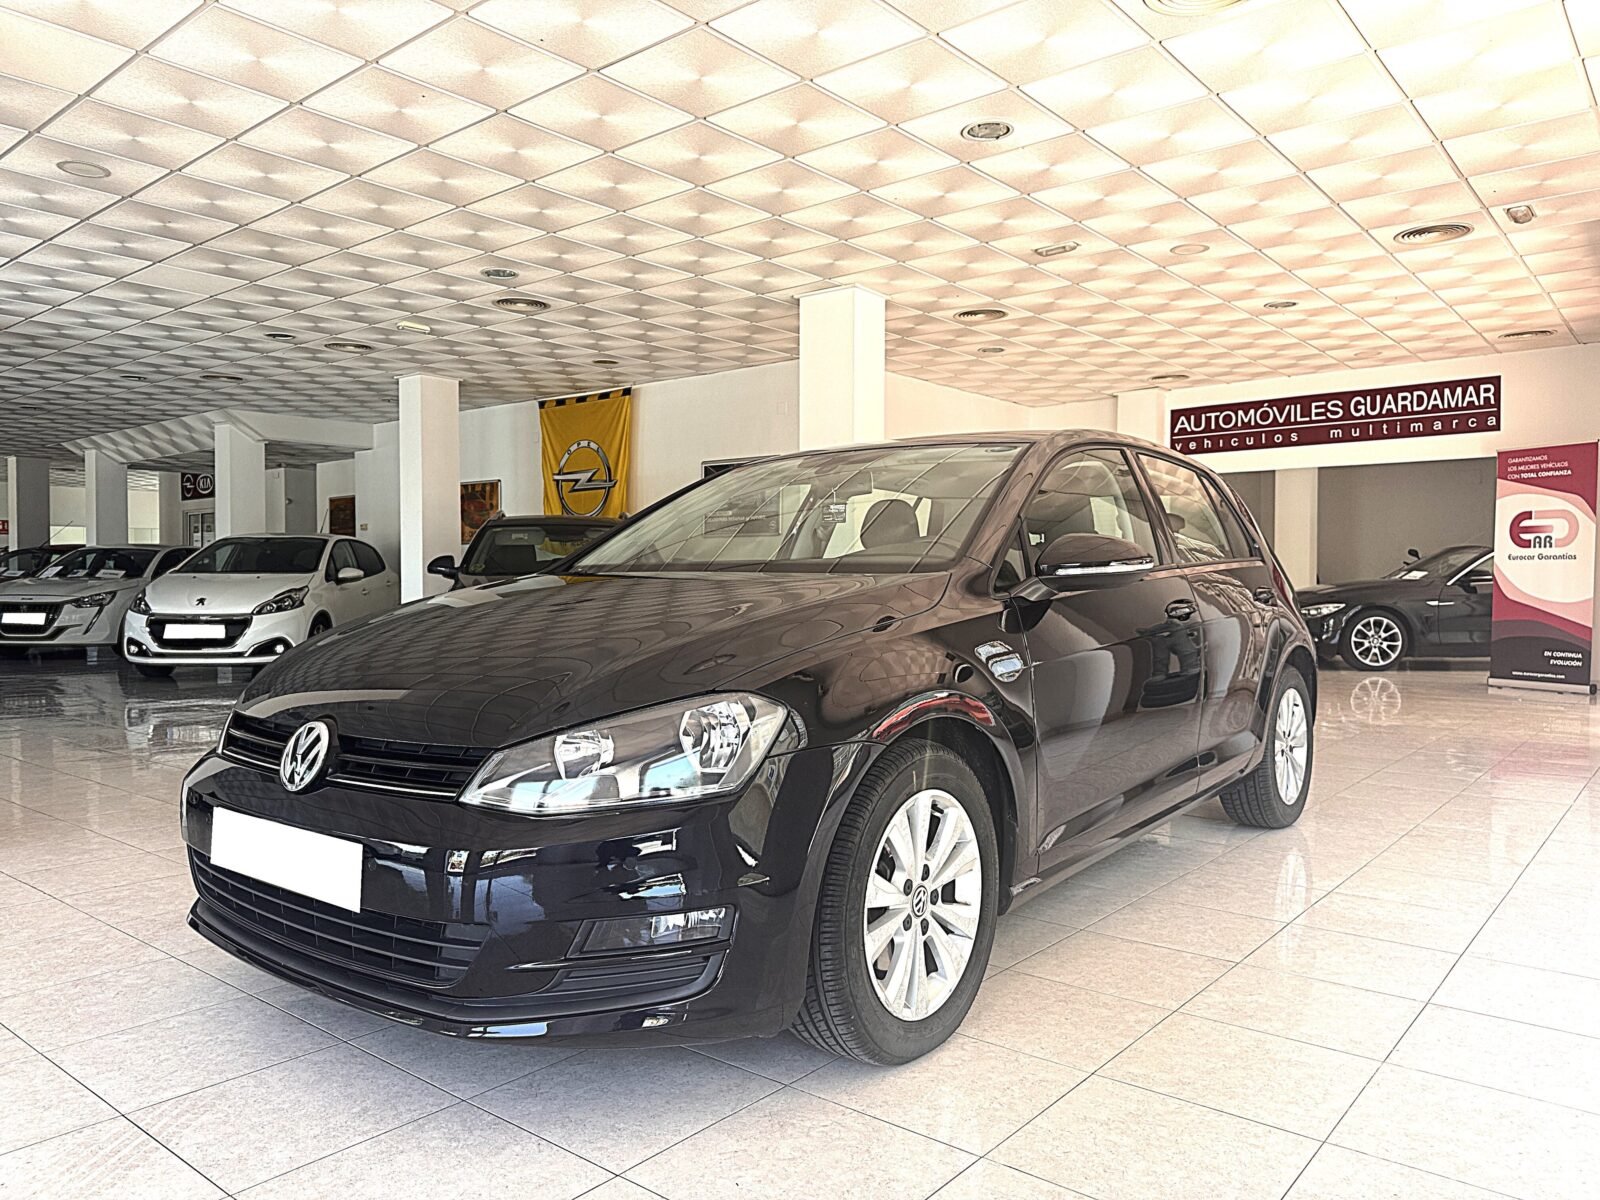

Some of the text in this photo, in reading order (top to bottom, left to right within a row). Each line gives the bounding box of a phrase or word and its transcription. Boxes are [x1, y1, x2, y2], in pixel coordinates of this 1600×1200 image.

[1174, 384, 1495, 433] AUTOMÓVILES GUARDAMAR
[1330, 416, 1497, 439] multimarca
[567, 441, 601, 455] OPEL
[1508, 455, 1548, 463] GARANTIZAMOS
[1508, 552, 1577, 561] Eurocar Garantías
[1550, 659, 1582, 667] EVOLUCIÓN
